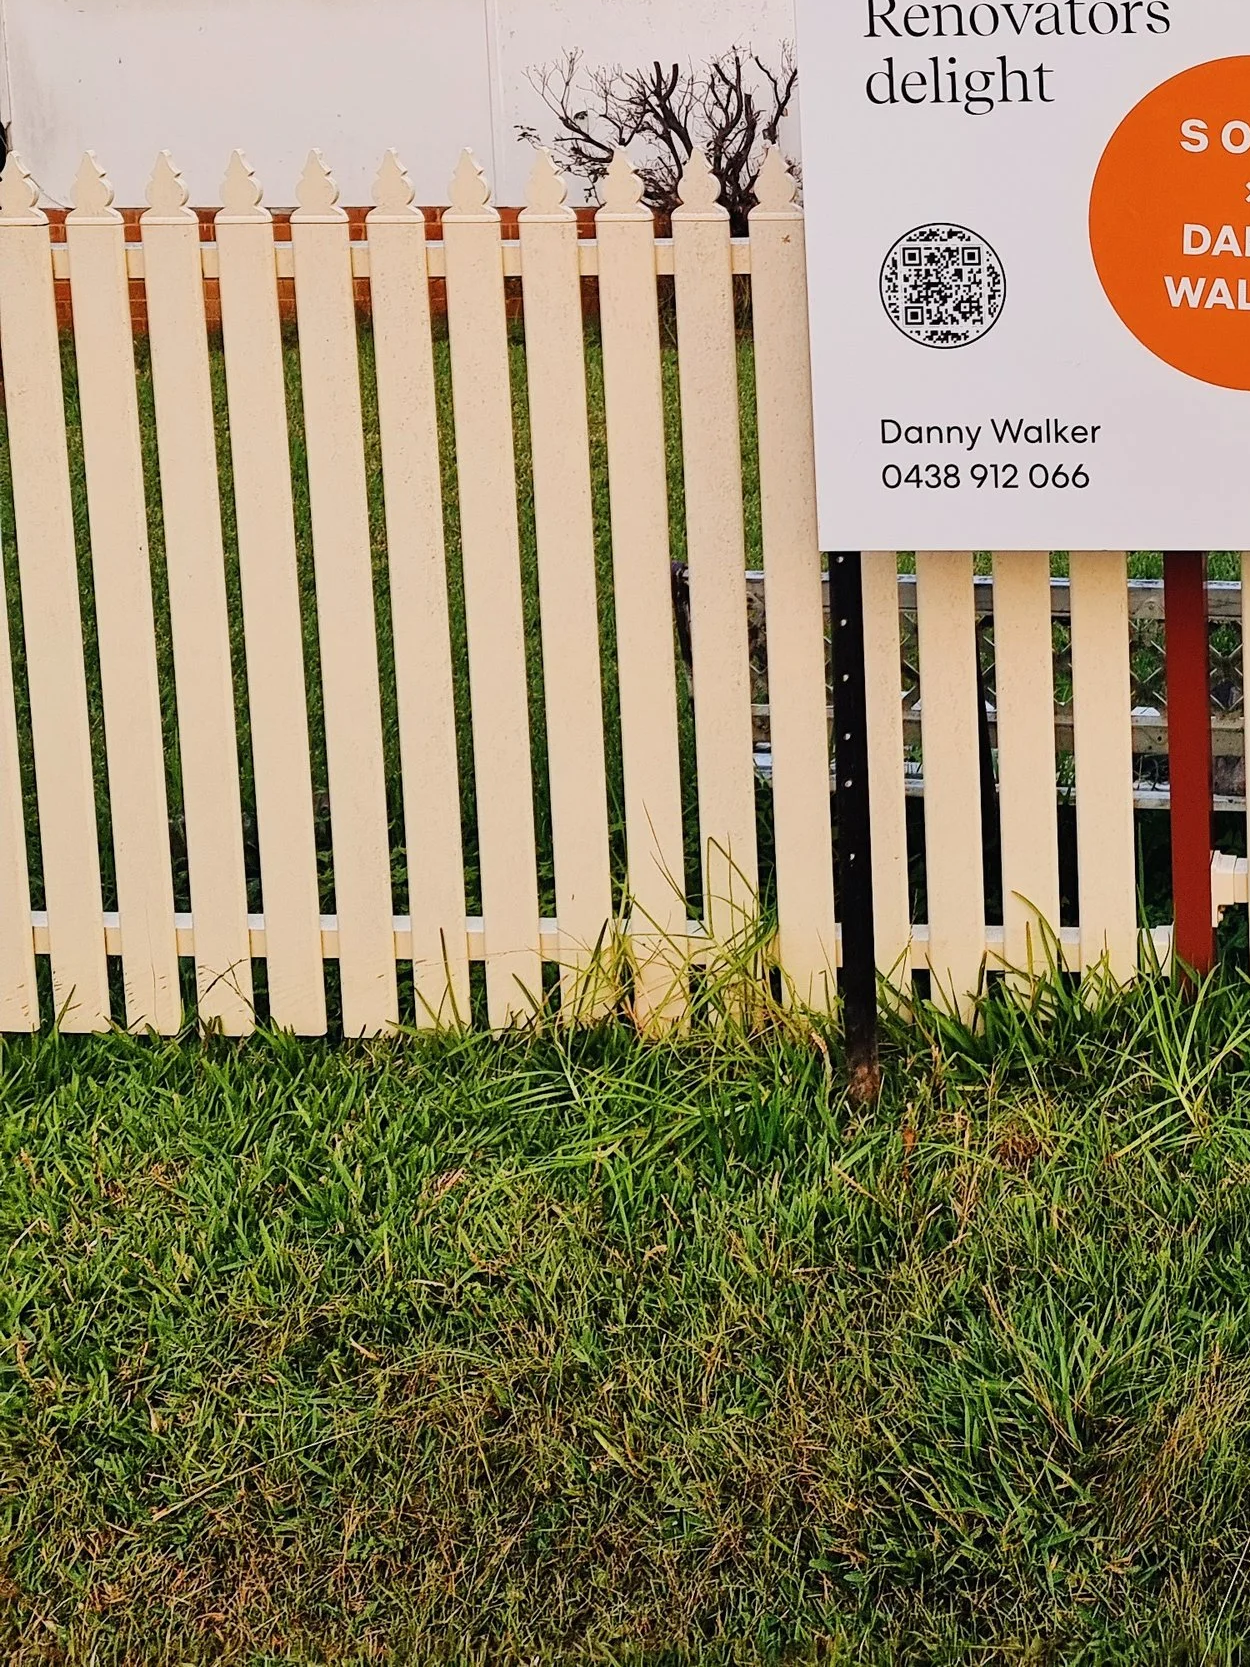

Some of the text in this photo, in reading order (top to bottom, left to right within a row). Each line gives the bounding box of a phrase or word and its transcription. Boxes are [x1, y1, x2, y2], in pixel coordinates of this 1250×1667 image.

[865, 55, 1054, 115] delight
[880, 418, 1101, 451] Danny Walker
[881, 463, 1089, 489] 0438 912 066
